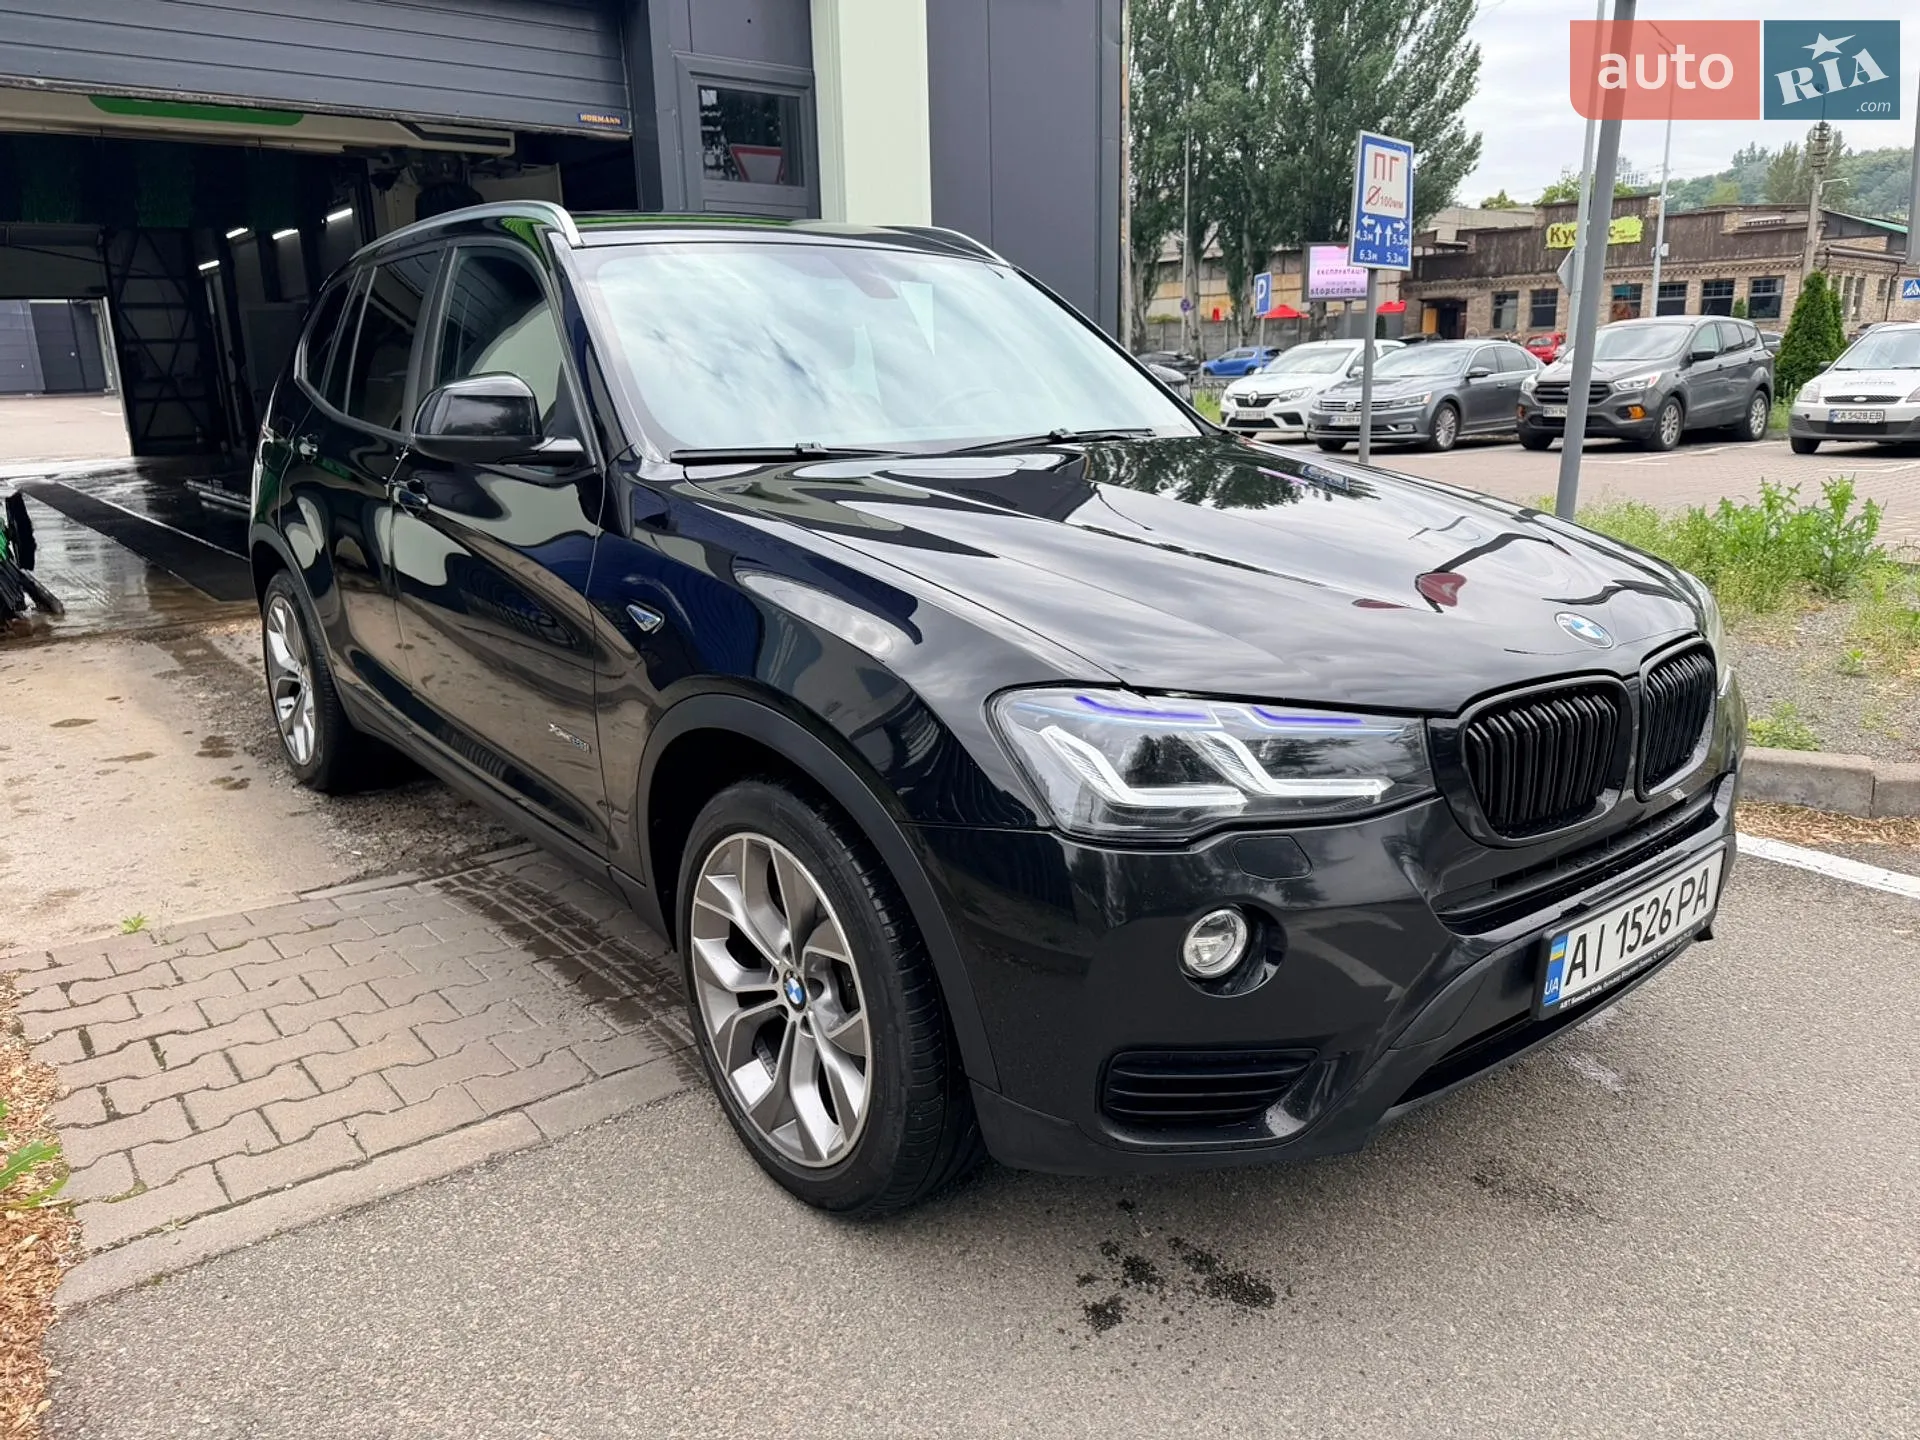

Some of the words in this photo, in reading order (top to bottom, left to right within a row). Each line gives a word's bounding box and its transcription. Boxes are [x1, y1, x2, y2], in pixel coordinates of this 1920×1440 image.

[1374, 152, 1399, 181] ПГ
[1257, 279, 1267, 310] P
[1310, 287, 1366, 296] stopcrime.u
[1564, 923, 1605, 986] AI
[1616, 886, 1675, 959] 1526
[1675, 867, 1710, 927] PA
[1544, 976, 1560, 996] UA
